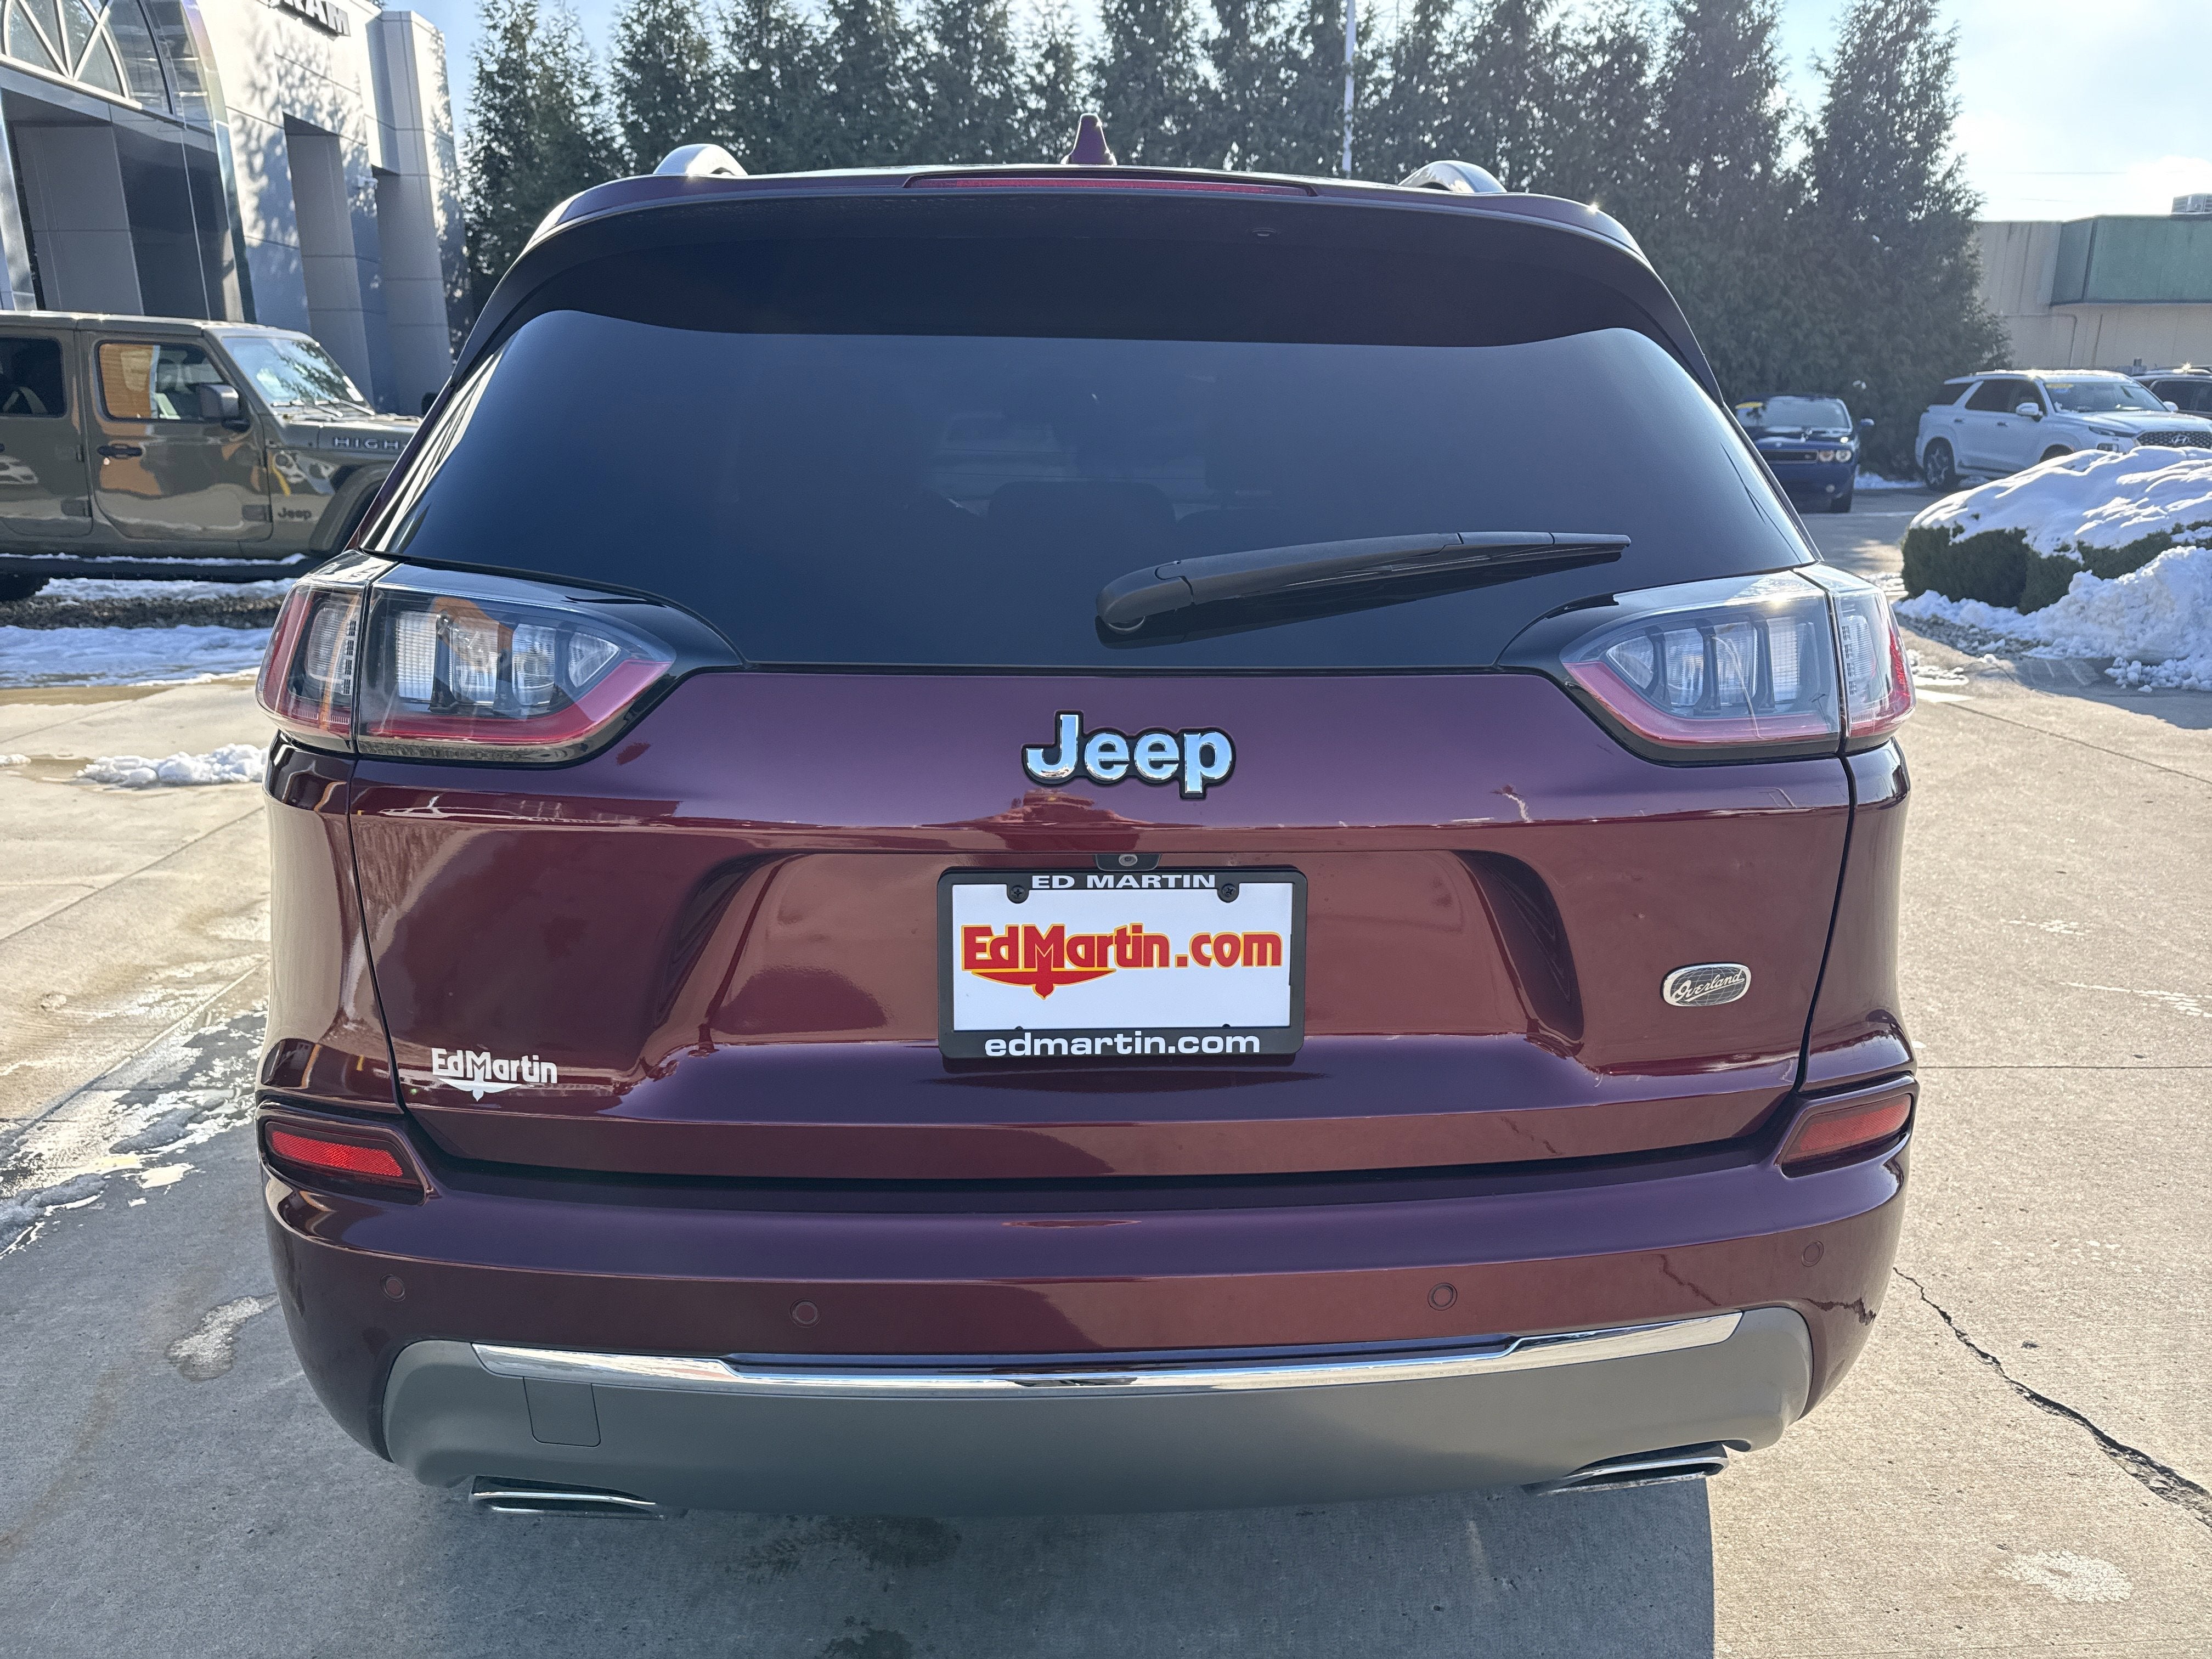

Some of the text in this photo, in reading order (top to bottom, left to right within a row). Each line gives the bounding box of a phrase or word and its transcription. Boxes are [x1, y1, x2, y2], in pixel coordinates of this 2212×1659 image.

[278, 507, 312, 520] Jeep
[1024, 712, 1234, 796] Jeep
[1031, 874, 1216, 889] ED MARTIN
[1671, 969, 1745, 1003] Overland
[985, 1030, 1260, 1057] edmartin.com
[431, 1047, 558, 1085] EdMartin
